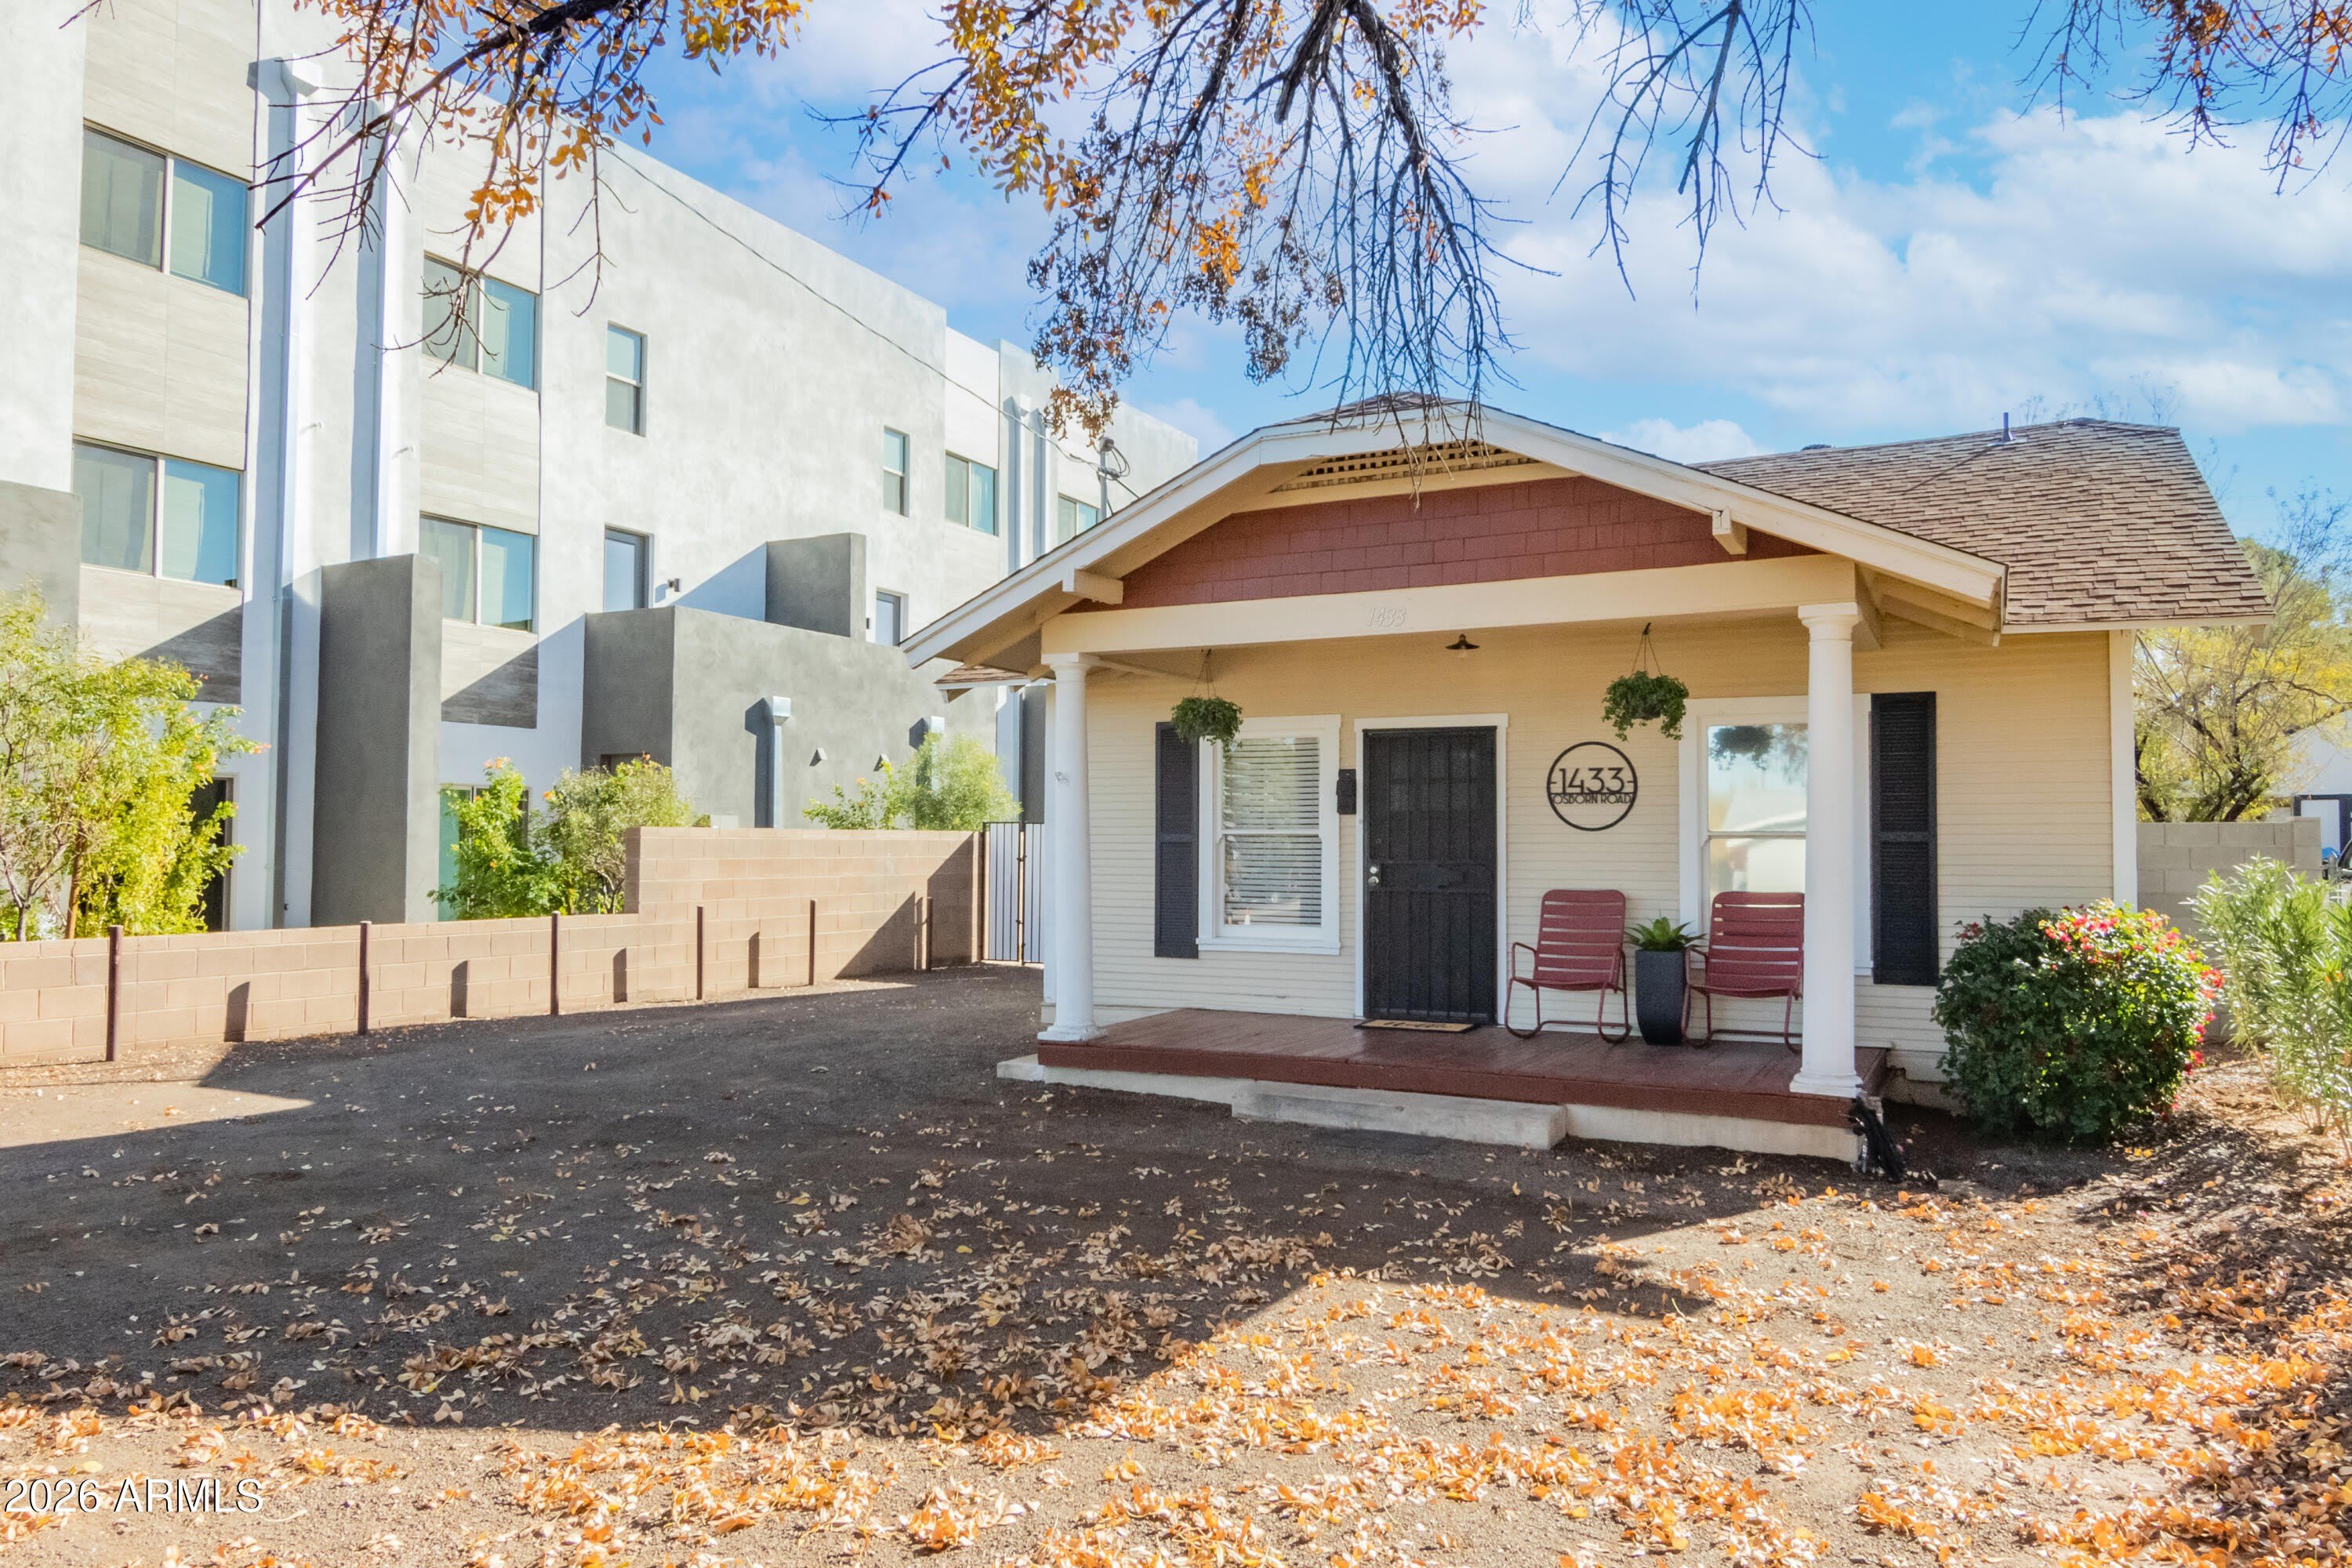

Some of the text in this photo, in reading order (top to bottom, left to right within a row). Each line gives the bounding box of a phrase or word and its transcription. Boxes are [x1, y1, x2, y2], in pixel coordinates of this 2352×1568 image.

[1367, 608, 1406, 627] 1433
[1559, 768, 1624, 794] 1433
[1553, 793, 1631, 804] OSBORN ROAD
